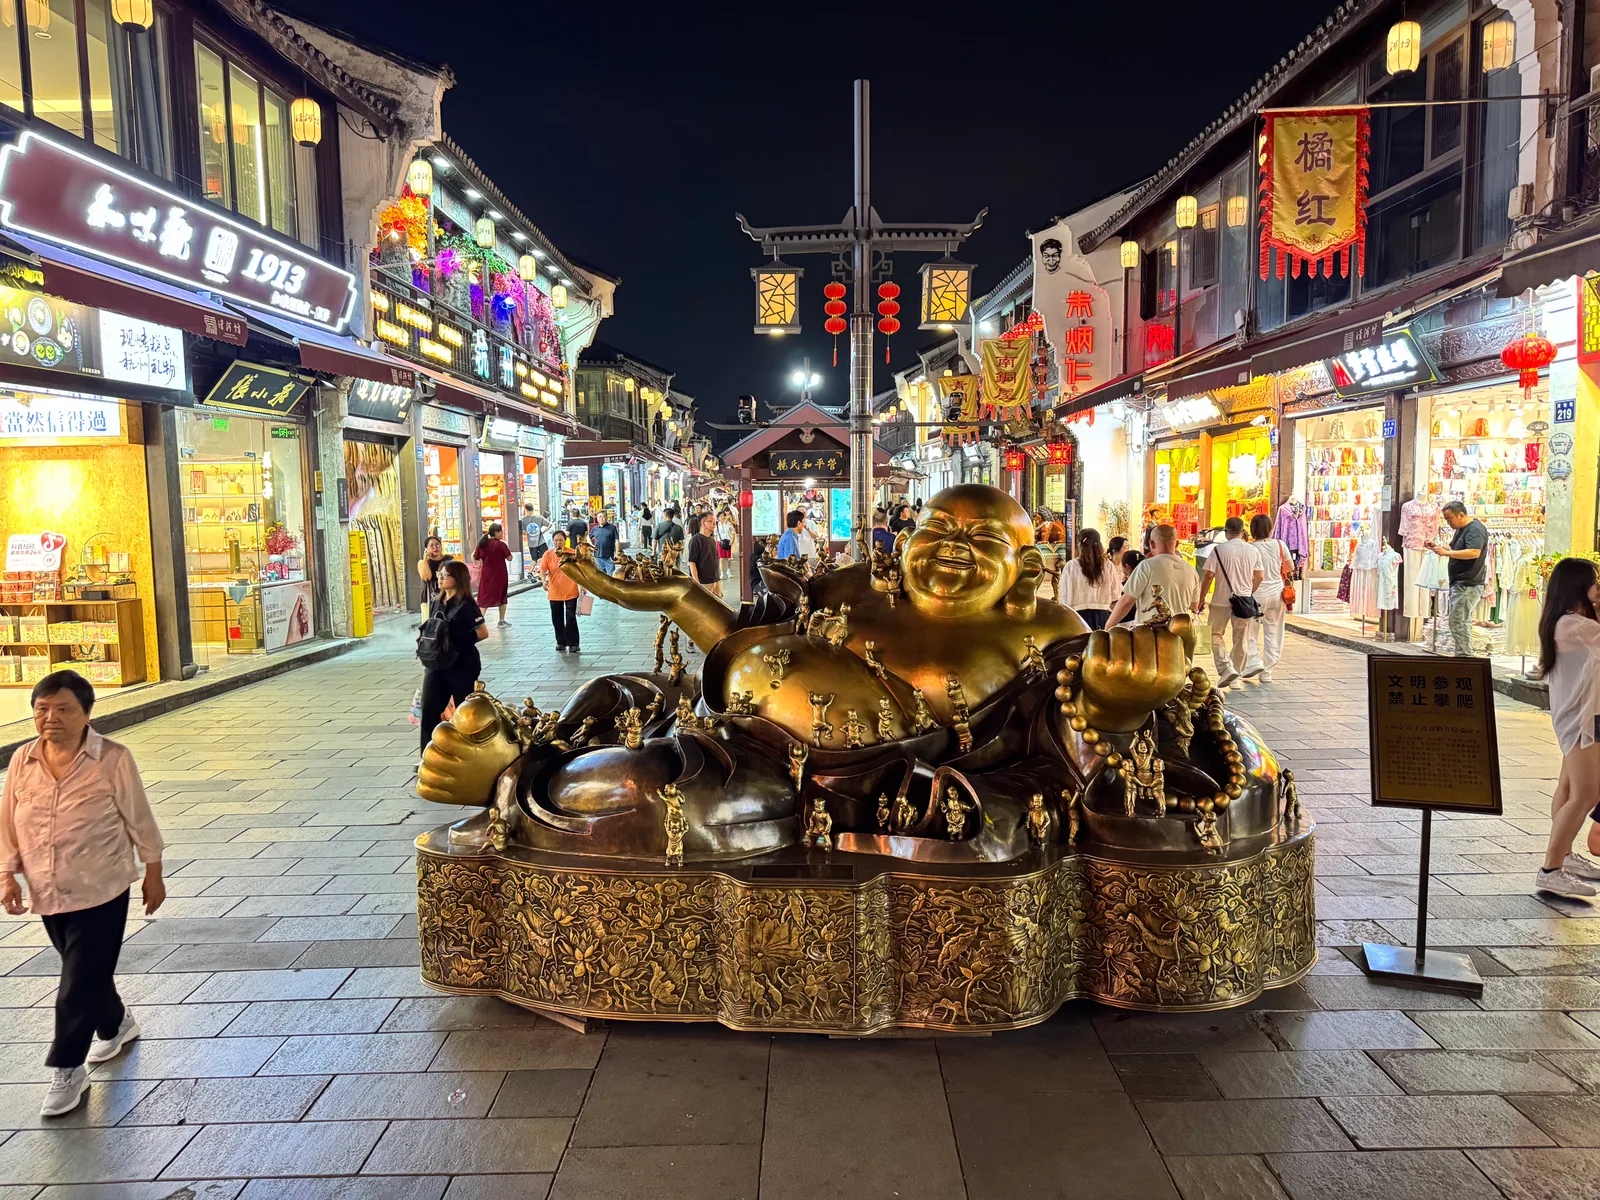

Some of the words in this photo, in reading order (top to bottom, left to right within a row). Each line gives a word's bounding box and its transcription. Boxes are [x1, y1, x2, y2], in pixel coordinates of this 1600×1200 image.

[1294, 131, 1337, 227] 橘红
[241, 248, 306, 294] 1913
[0, 410, 107, 433] 當然信得過
[1557, 408, 1572, 421] 219
[1384, 426, 1393, 436] 217
[1387, 674, 1473, 691] 文明参观
[1387, 691, 1474, 709] 禁止攀爬
